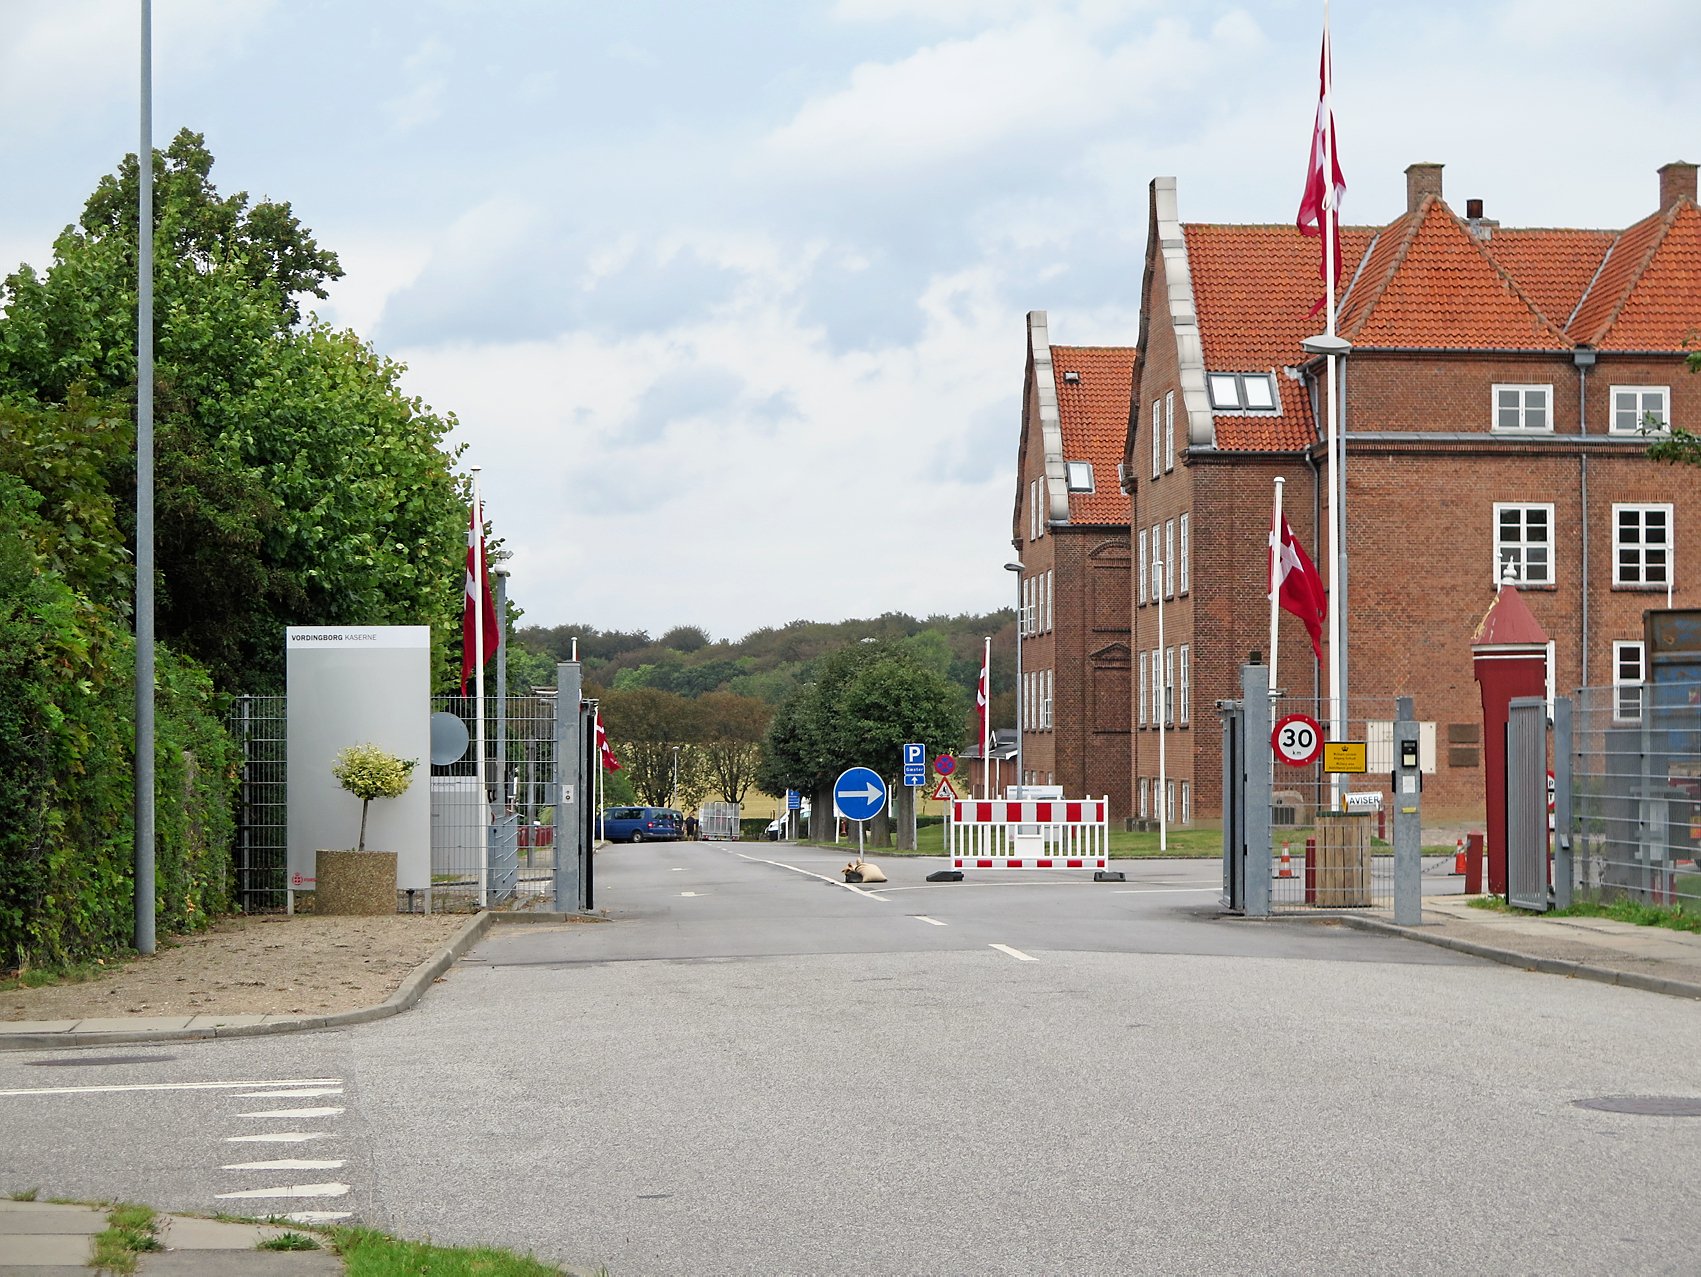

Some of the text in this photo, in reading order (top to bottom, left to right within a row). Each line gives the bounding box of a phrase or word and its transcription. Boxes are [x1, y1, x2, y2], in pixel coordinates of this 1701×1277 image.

[1282, 728, 1313, 748] 30
[909, 746, 921, 762] P
[1349, 795, 1380, 805] AVISER
